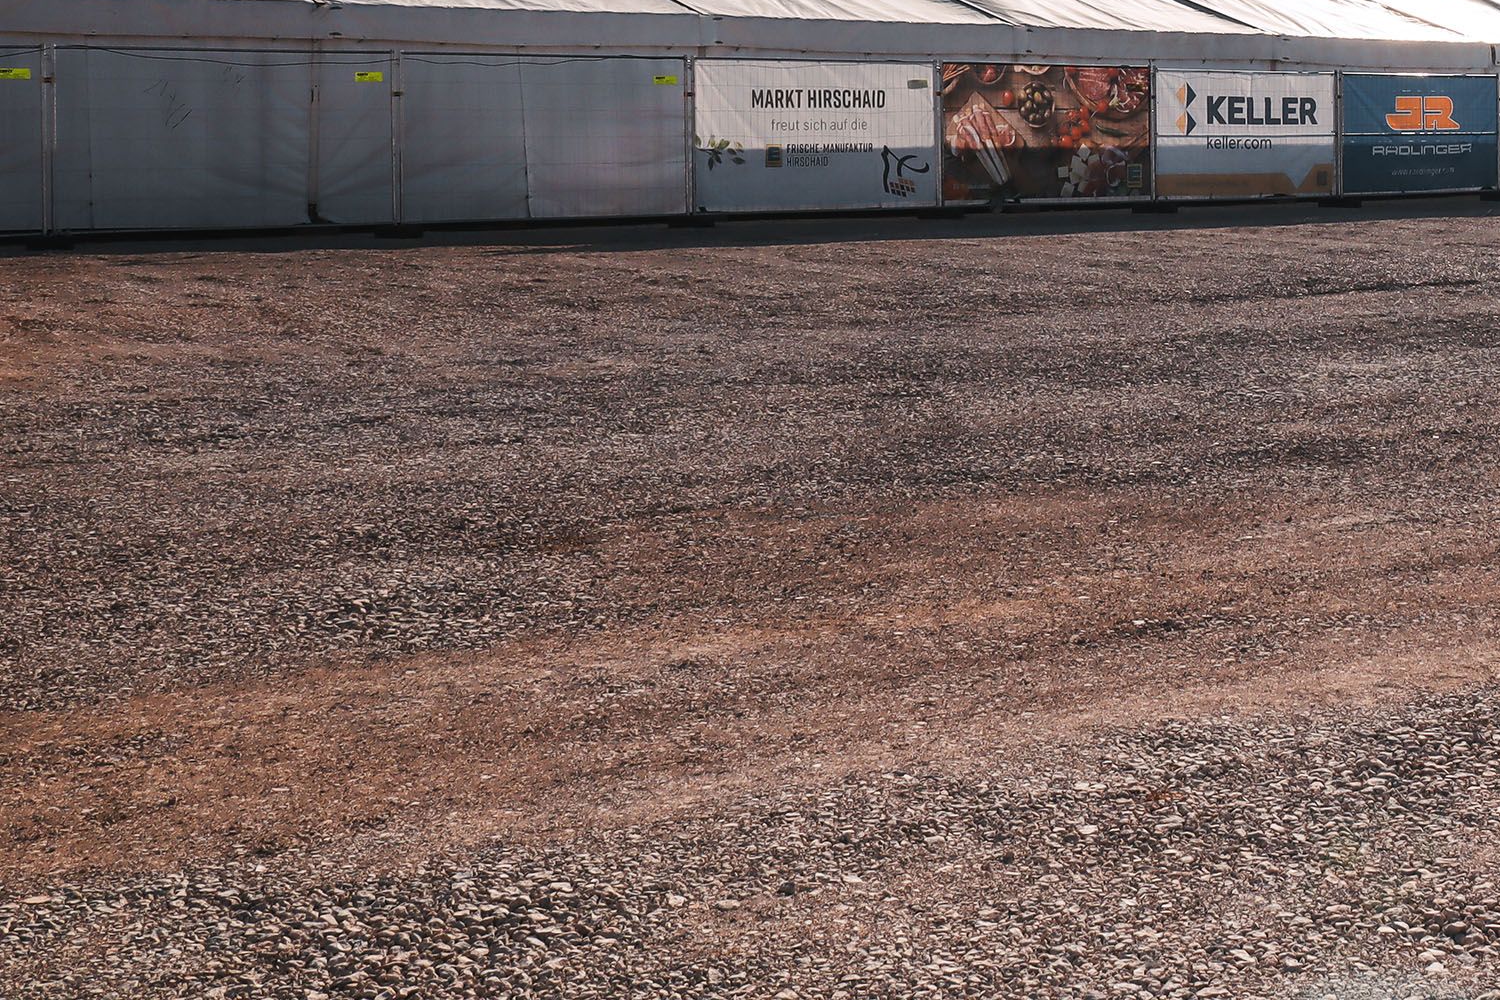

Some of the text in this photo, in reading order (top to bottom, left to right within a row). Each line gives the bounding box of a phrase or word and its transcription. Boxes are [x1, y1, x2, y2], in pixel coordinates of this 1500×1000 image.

[751, 89, 886, 109] MARKT HIRSCHAID
[1206, 96, 1318, 125] KELLER
[771, 118, 868, 131] freut sich auf die
[1206, 136, 1272, 150] keller.com
[786, 156, 829, 168] HIRSCHAID
